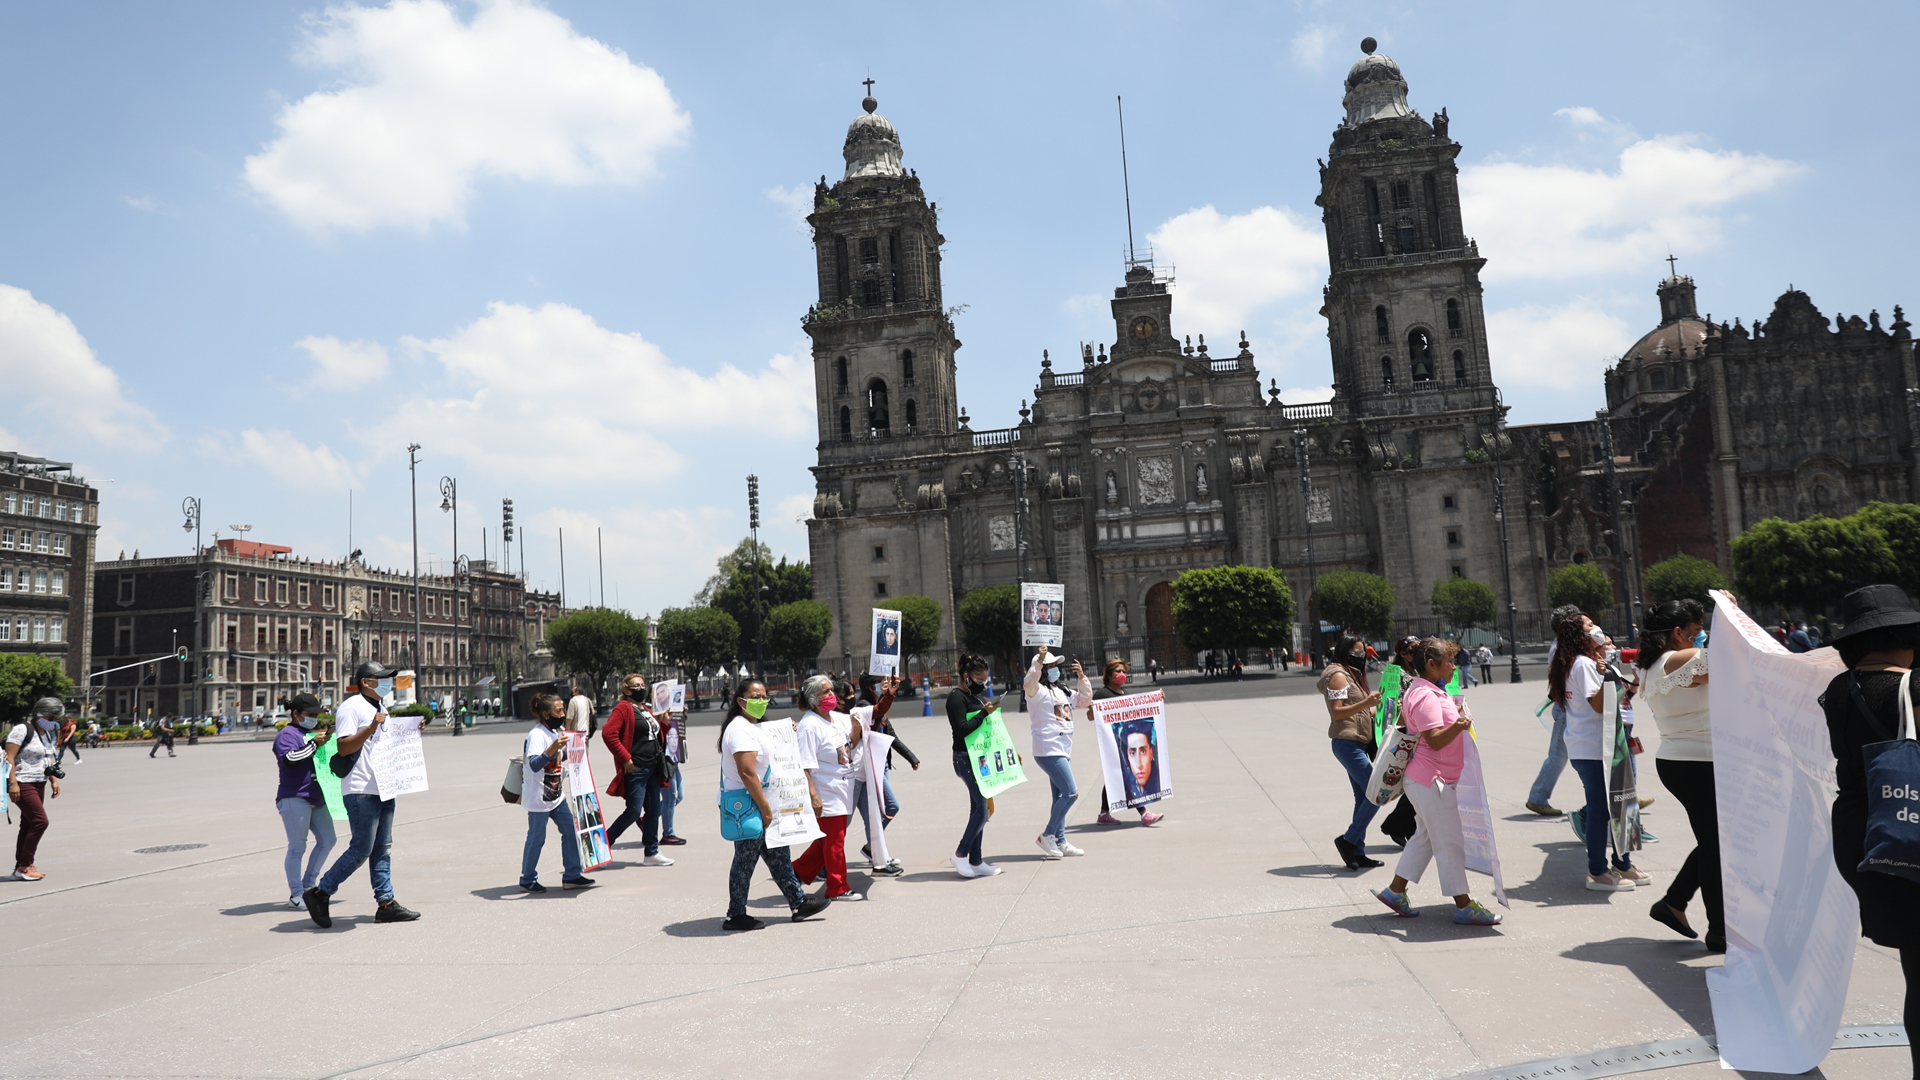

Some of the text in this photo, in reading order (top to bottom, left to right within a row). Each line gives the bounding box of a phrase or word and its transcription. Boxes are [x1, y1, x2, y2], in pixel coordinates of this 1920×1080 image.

[1094, 693, 1163, 712] TE SEGUIMOS BUSCANDO
[1102, 705, 1161, 723] HASTA ENCONTRARTE
[1881, 784, 1920, 802] Bols
[1896, 806, 1919, 824] de
[1590, 1045, 1694, 1067] levantar
